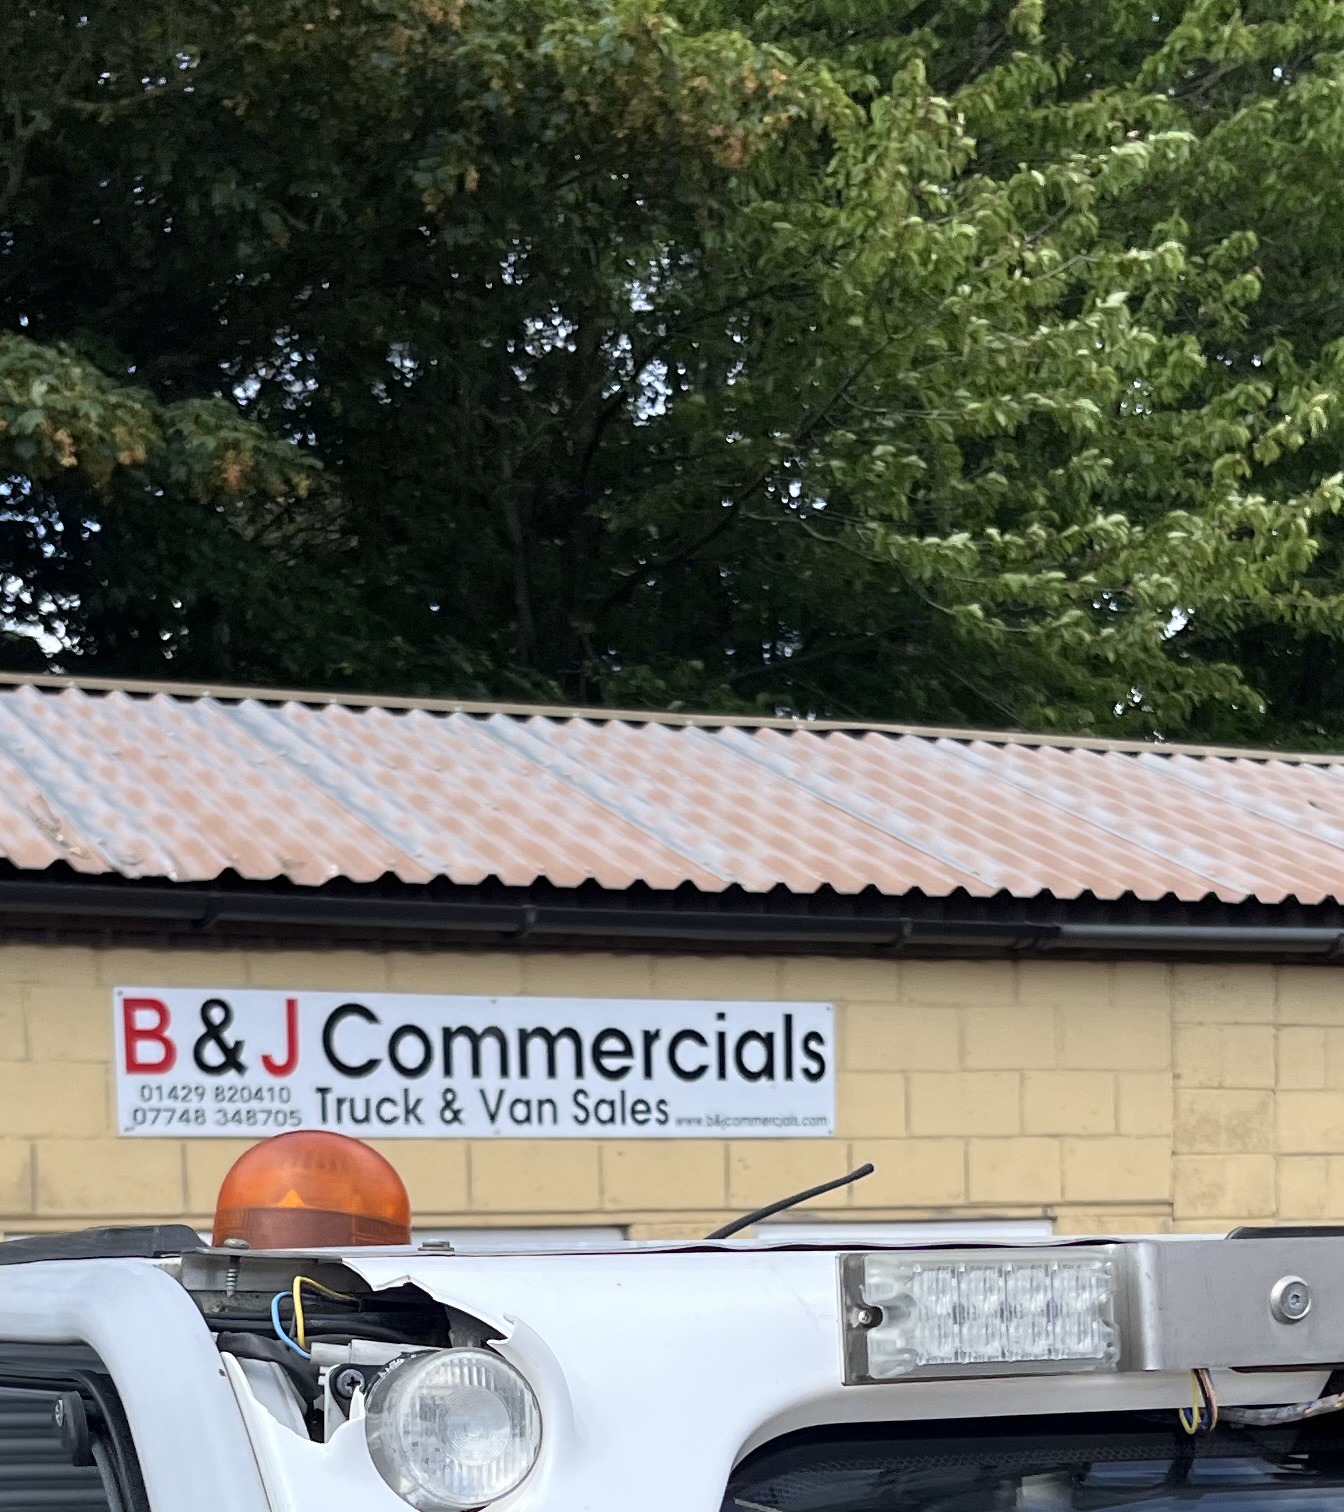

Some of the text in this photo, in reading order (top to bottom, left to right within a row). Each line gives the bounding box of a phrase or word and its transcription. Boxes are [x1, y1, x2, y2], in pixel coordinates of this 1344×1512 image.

[122, 997, 827, 1083] B & J Commercials
[139, 1084, 292, 1105] 01429 820410
[315, 1087, 670, 1126] Truck & Van Sales
[132, 1107, 303, 1128] 07748 348705
